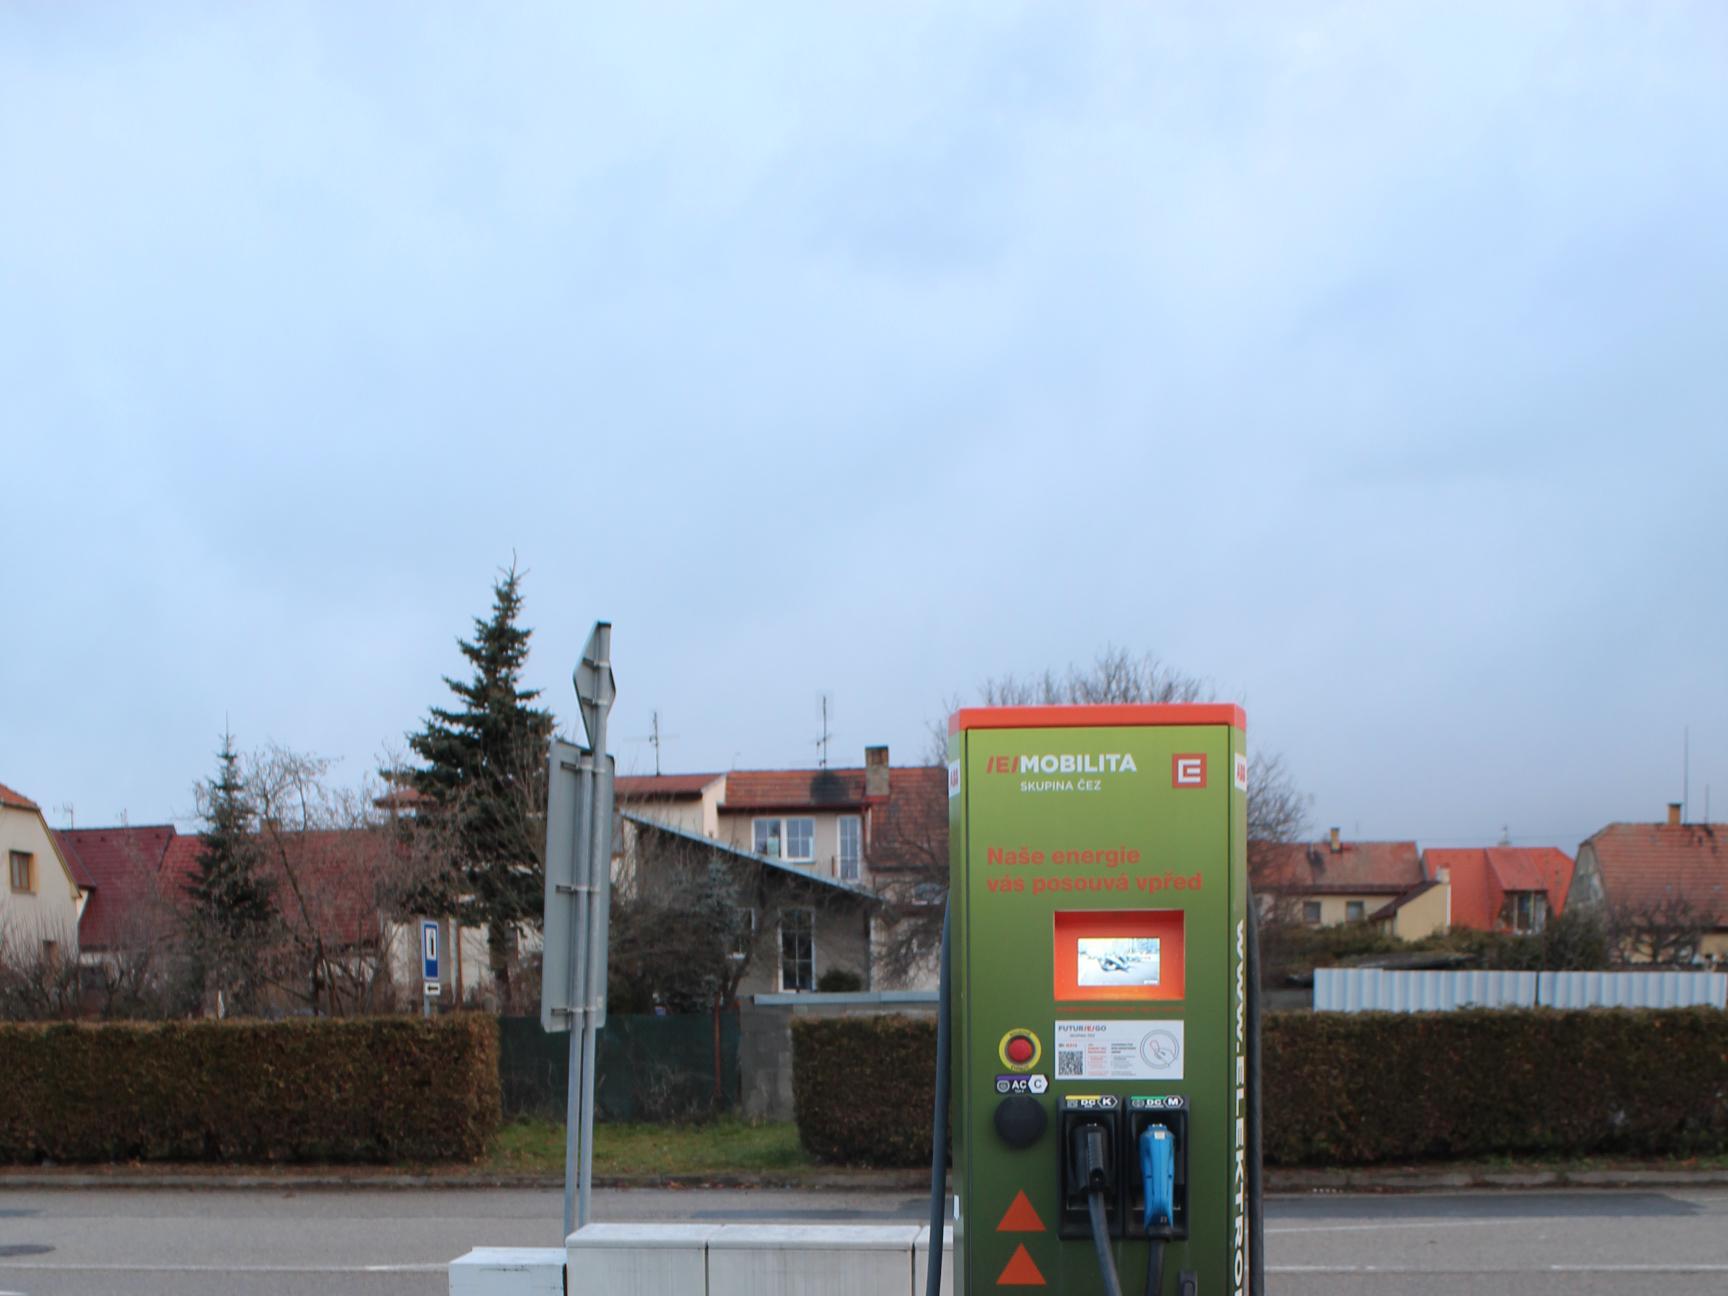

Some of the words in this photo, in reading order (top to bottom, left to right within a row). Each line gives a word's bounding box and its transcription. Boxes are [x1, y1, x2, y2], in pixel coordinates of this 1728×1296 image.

[1020, 780, 1074, 792] SKUPINA
[1077, 778, 1102, 792] ČEZ
[987, 846, 1045, 866] Naše
[1051, 846, 1140, 868] energie
[987, 874, 1025, 894] vás
[1032, 873, 1129, 897] posouvá
[1136, 871, 1203, 896] vpřed
[1011, 1080, 1027, 1090] AC
[1034, 1079, 1042, 1089] C
[1102, 1098, 1112, 1106] K
[1168, 1097, 1179, 1106] M
